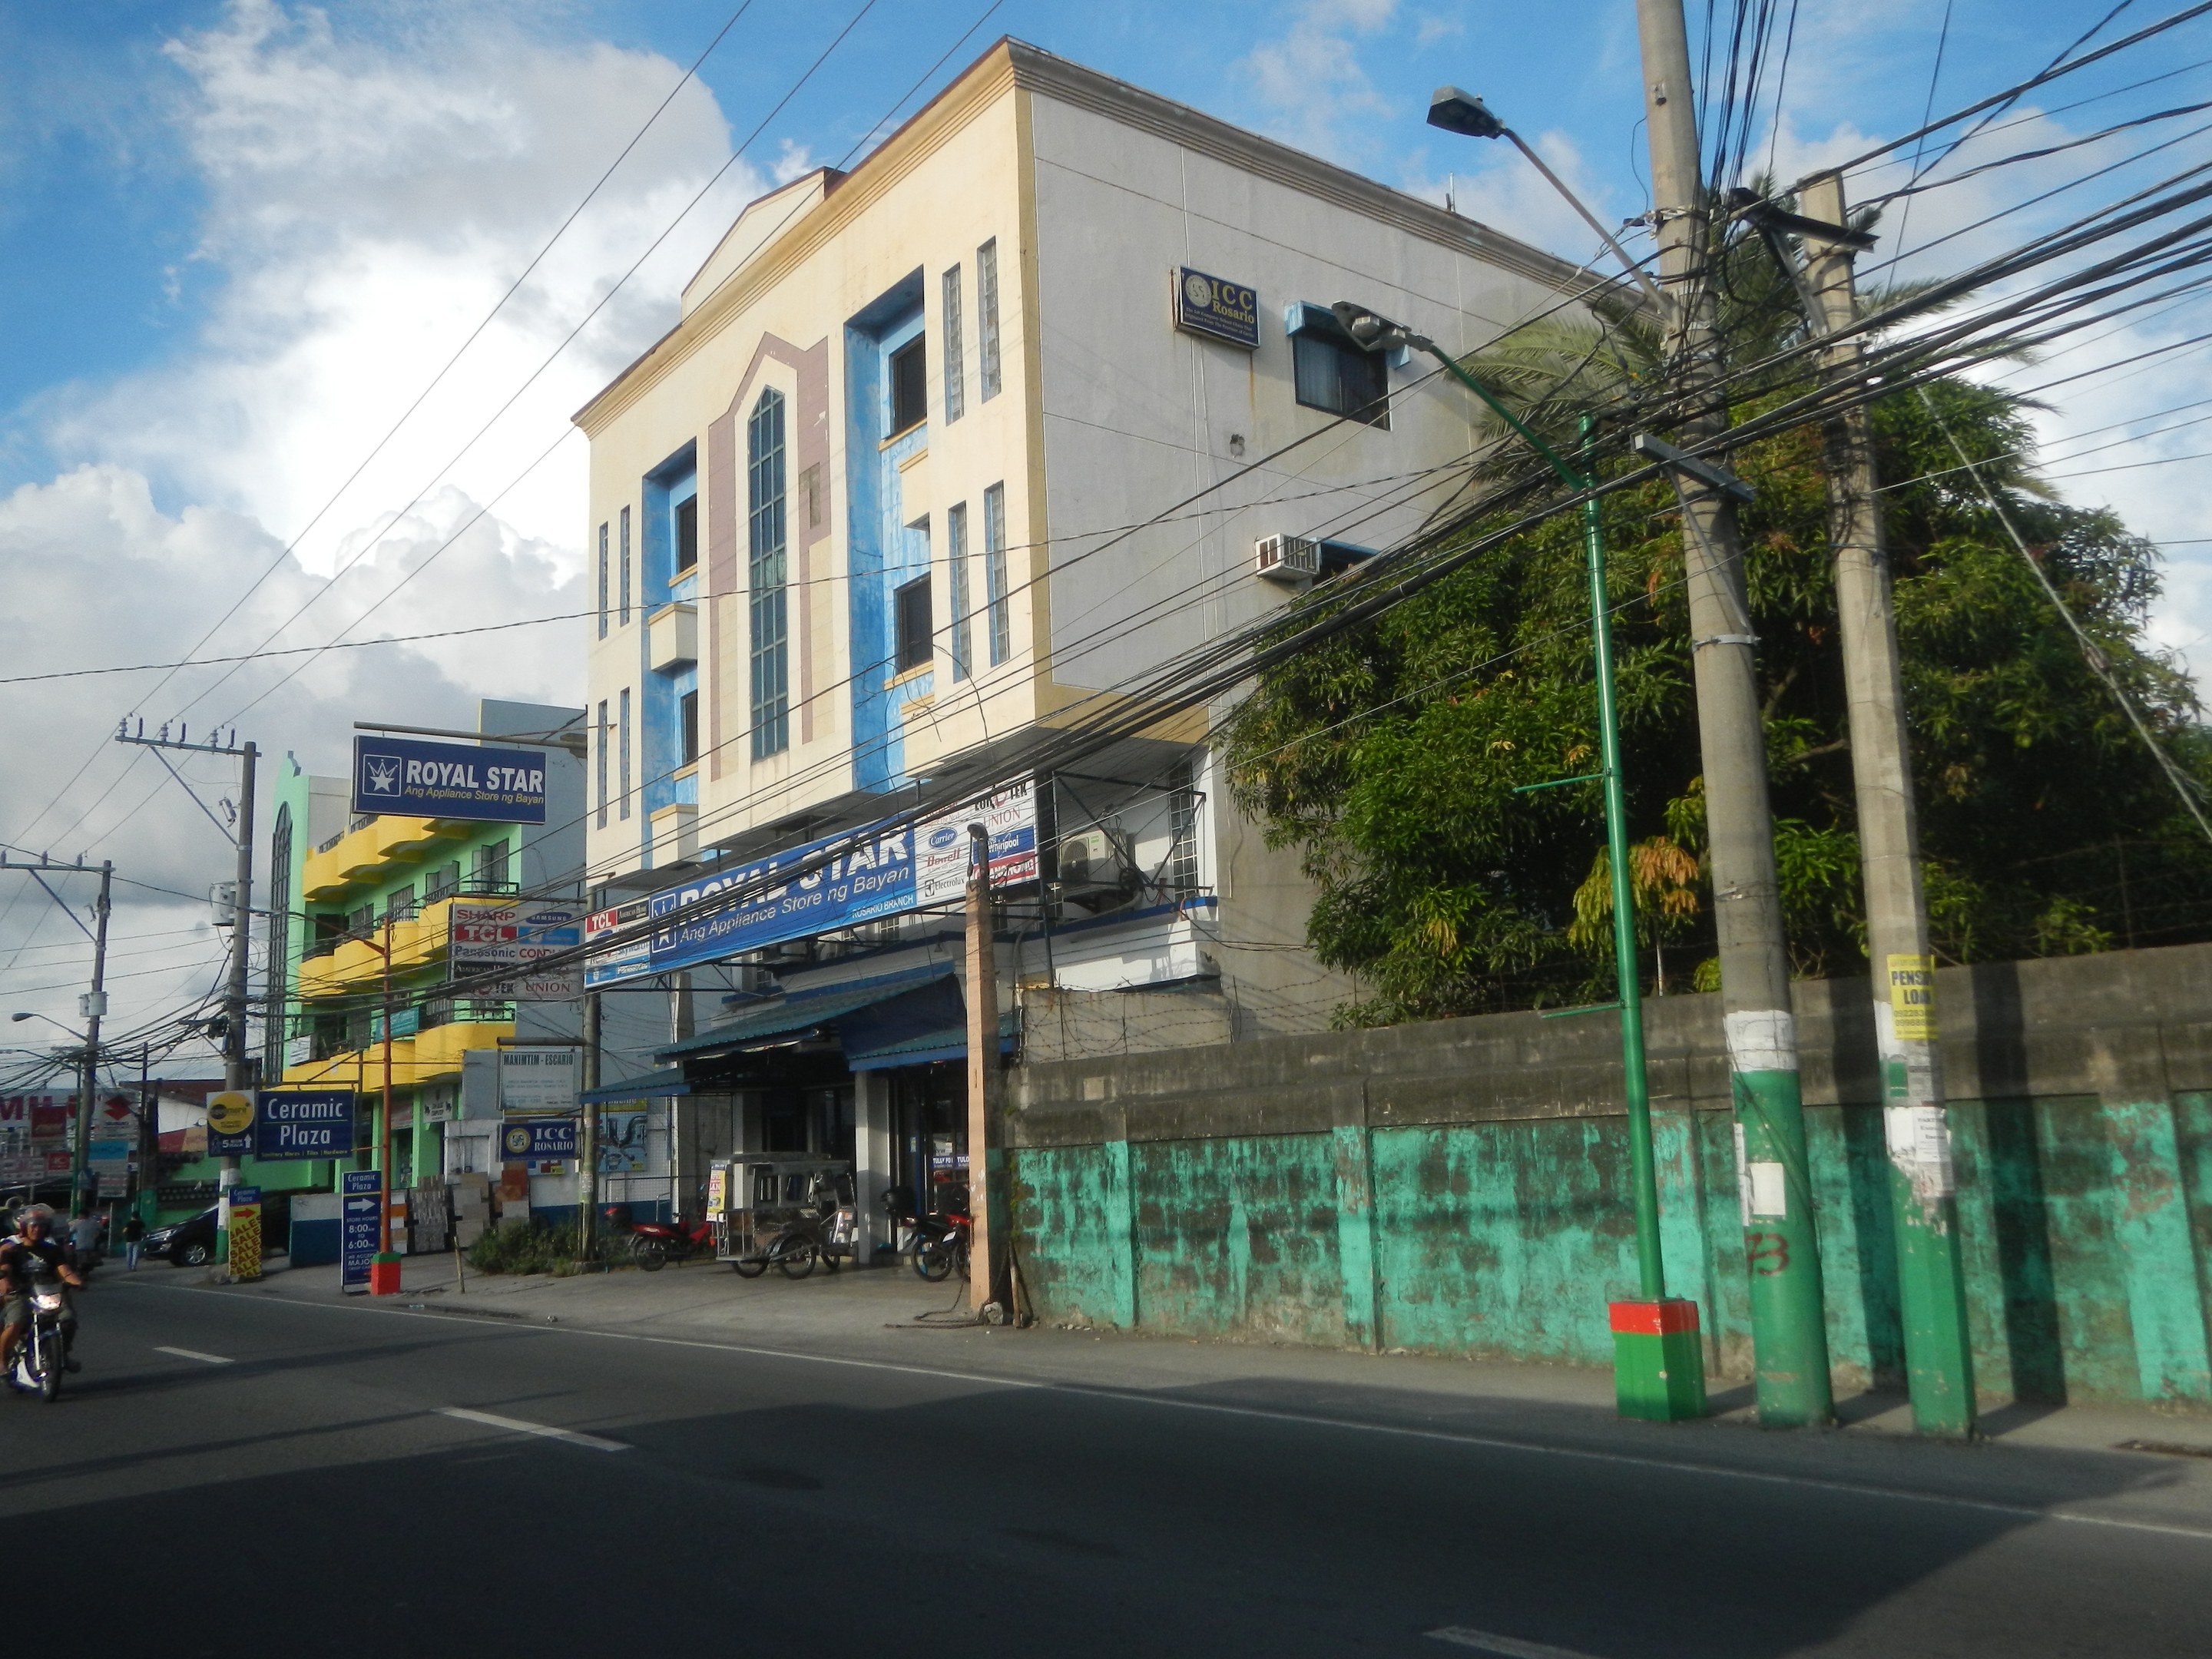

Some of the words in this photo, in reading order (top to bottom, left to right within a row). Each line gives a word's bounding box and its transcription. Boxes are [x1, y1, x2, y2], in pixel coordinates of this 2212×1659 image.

[1212, 280, 1253, 310] ICC
[1212, 300, 1254, 324] Rosario
[406, 760, 479, 788] ROYAL
[486, 767, 543, 793] STAR
[404, 786, 424, 797] Ang
[426, 786, 472, 800] Appliance
[475, 790, 499, 801] Store
[502, 795, 513, 804] ng
[515, 794, 544, 805] Bayan
[983, 806, 1021, 829] UNION
[930, 831, 955, 846] Carrier
[800, 824, 908, 890] STAR
[935, 876, 965, 891] Electrolux
[680, 925, 706, 943] Ang
[709, 904, 777, 935] Appliance
[781, 893, 823, 914] Store
[827, 884, 848, 903] ng
[853, 866, 909, 894] Bayan
[883, 895, 914, 910] BRANCH
[457, 909, 516, 921] SHARP
[591, 912, 612, 931] TCL
[464, 925, 508, 942] TCL
[454, 945, 515, 959] Panasonic
[525, 982, 570, 993] UNION
[545, 1054, 574, 1065] ESCARIO
[267, 1098, 343, 1119] Ceramic
[280, 1124, 331, 1146] Plaza
[535, 1127, 571, 1140] ICC
[222, 1139, 229, 1148] 5
[534, 1141, 574, 1151] ROSARIO
[348, 1174, 376, 1183] Ceramic
[352, 1182, 372, 1190] Plaza
